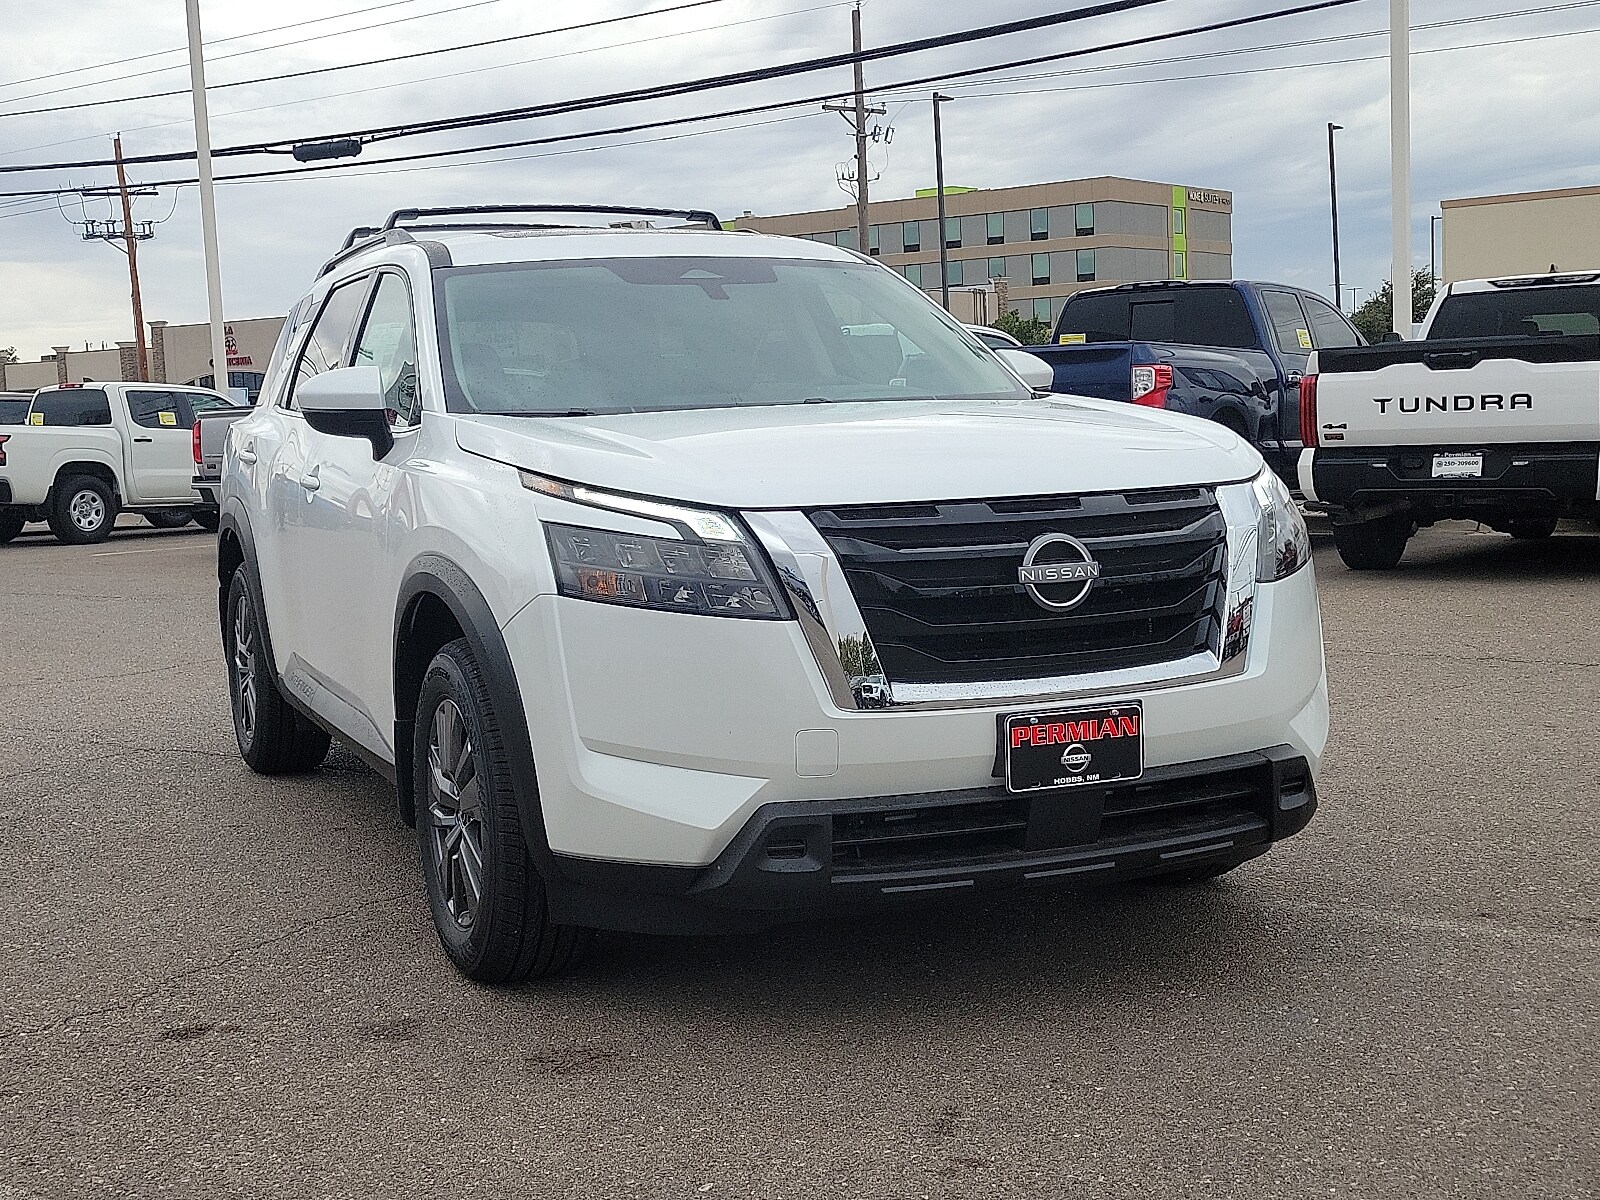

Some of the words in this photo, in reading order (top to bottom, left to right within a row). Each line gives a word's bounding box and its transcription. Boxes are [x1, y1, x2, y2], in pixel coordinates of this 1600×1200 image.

[1372, 393, 1533, 414] TUNDRA
[1021, 564, 1098, 581] NISSAN
[1011, 715, 1139, 749] PERMIAN
[1062, 754, 1090, 764] NISSAN
[1053, 775, 1085, 785] HOBBS,
[1086, 773, 1100, 782] NM
